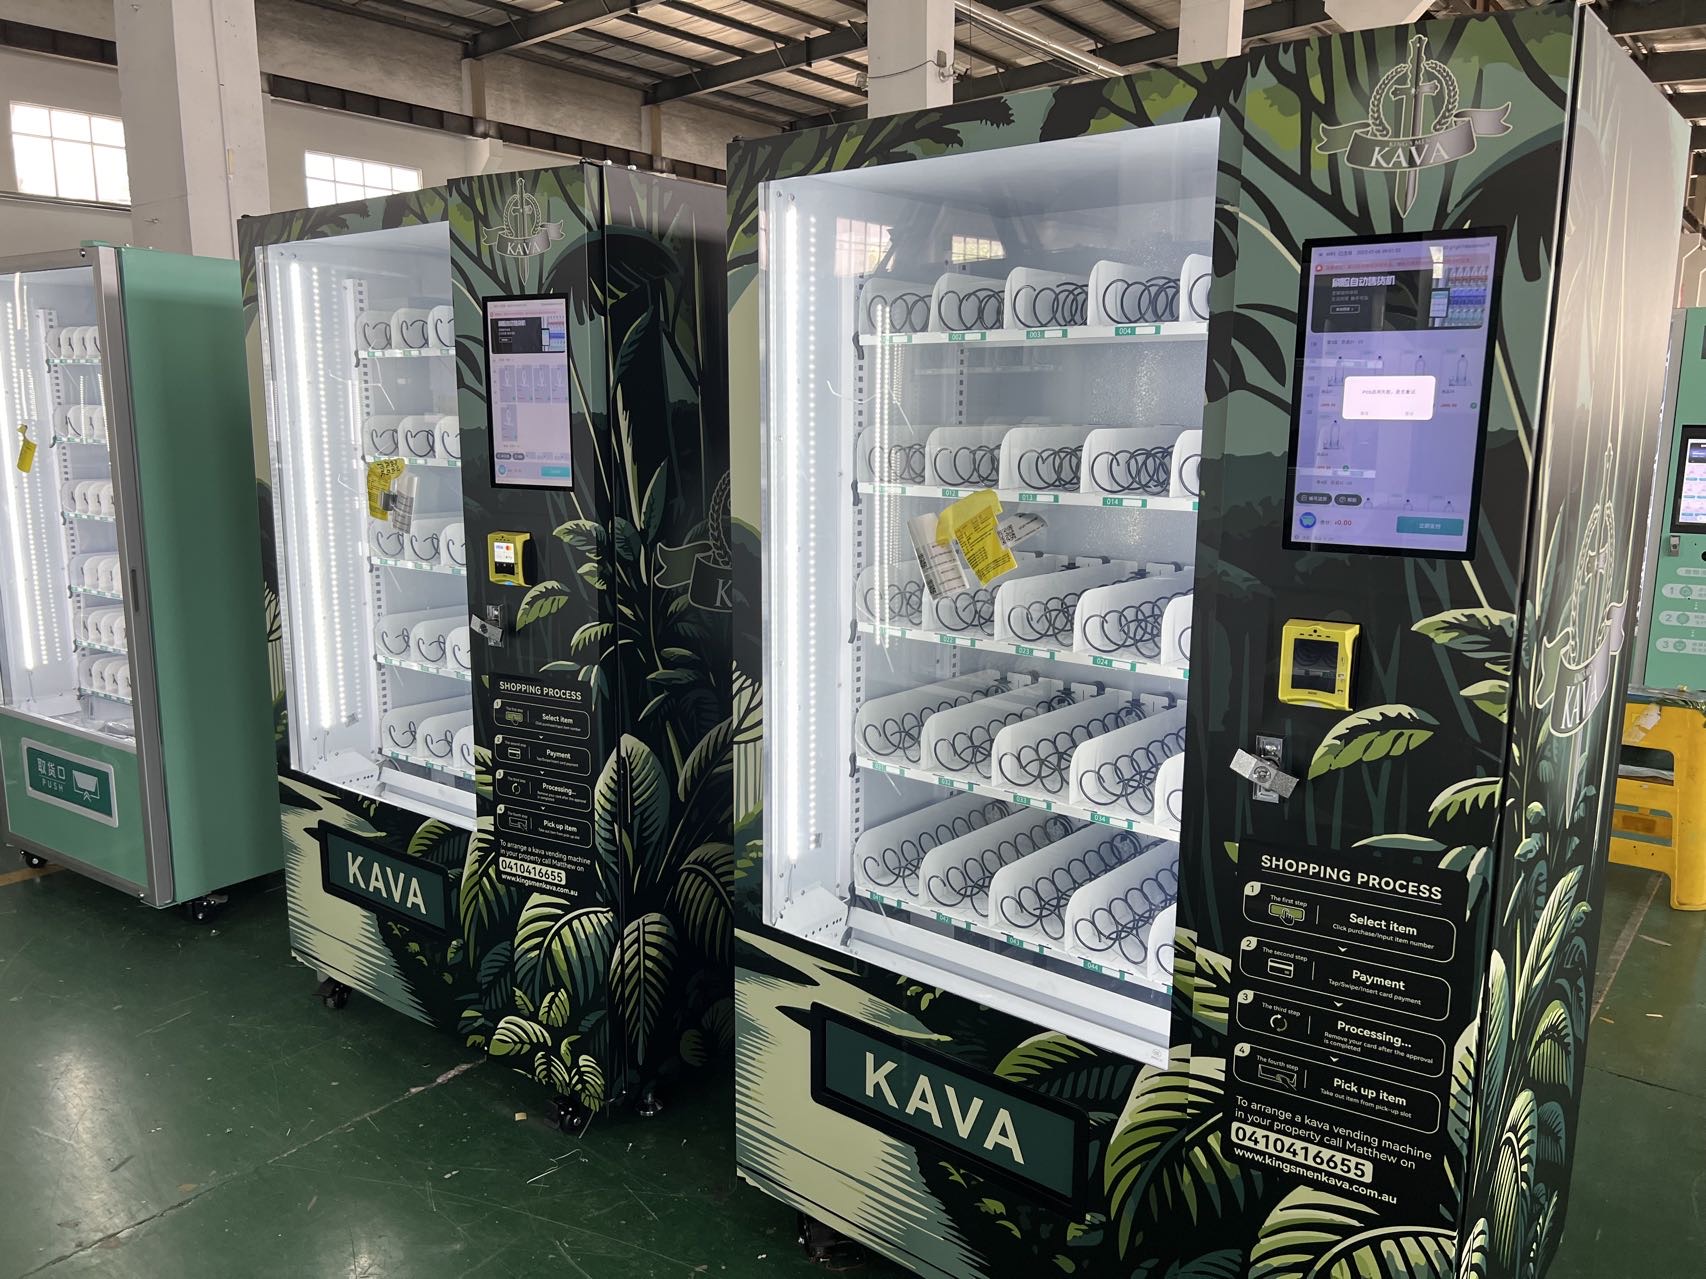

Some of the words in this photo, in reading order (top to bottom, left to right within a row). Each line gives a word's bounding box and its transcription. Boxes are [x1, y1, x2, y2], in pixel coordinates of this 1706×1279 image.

[1370, 142, 1450, 168] KAVA
[508, 241, 540, 255] KAVA
[500, 681, 541, 695] SHOPPING
[544, 688, 582, 700] PROCESS
[1561, 672, 1597, 729] KAVA
[542, 713, 559, 722] Select
[561, 716, 573, 724] item
[546, 749, 570, 759] Payment
[37, 758, 66, 780] 取货口
[42, 778, 64, 792] PUSH
[544, 820, 555, 828] Pick
[565, 823, 577, 832] item
[507, 842, 527, 852] arrange
[532, 846, 544, 854] kava
[546, 850, 567, 860] vending
[568, 855, 590, 865] machine
[519, 853, 541, 864] property
[552, 860, 575, 869] Matthew
[501, 860, 563, 882] 0410416655
[1261, 854, 1351, 882] SHOPPING
[1358, 872, 1442, 900] PROCESS
[347, 851, 427, 915] KAVA
[502, 873, 578, 896] www.kingsmenkava.com.au
[1270, 895, 1282, 903] The
[1282, 896, 1294, 904] first
[1294, 899, 1308, 907] step
[1349, 913, 1387, 930] Select
[1389, 920, 1417, 936] item
[1332, 923, 1347, 932] Click
[1348, 927, 1393, 942] purchase/Input
[1394, 936, 1409, 944] item
[1410, 939, 1435, 950] number
[1262, 946, 1272, 954] The
[1274, 949, 1294, 959] second
[1295, 953, 1308, 962] step
[1328, 978, 1378, 995] Tap/Swipe/Insert
[1379, 990, 1393, 999] card
[1394, 993, 1422, 1006] payment
[1352, 970, 1405, 991] Payment
[1262, 1002, 1272, 1010] The
[1273, 1004, 1287, 1013] third
[1288, 1008, 1301, 1017] step
[1337, 1020, 1412, 1048] Processing...
[1324, 1032, 1347, 1043] Remove
[1348, 1037, 1362, 1046] your
[1363, 1039, 1377, 1048] card
[1378, 1043, 1393, 1054] after
[1394, 1048, 1405, 1057] the
[1405, 1052, 1434, 1064] approval
[1330, 1040, 1361, 1052] completed
[1256, 1055, 1267, 1063] The
[1268, 1057, 1285, 1068] fourth
[1286, 1062, 1298, 1071] step
[1320, 1088, 1333, 1097] Take
[1345, 1095, 1359, 1104] item
[1360, 1099, 1374, 1107] from
[1375, 1103, 1398, 1114] pick-up
[1400, 1109, 1412, 1118] slot
[1334, 1078, 1358, 1094] Pick
[1360, 1085, 1377, 1099] up
[1380, 1089, 1407, 1106] item
[865, 1052, 1025, 1165] KAVA
[1235, 1108, 1245, 1118] in
[1247, 1113, 1271, 1127] your
[1274, 1122, 1321, 1142] property
[1323, 1134, 1343, 1148] call
[1346, 1140, 1398, 1164] Matthew
[1400, 1158, 1416, 1170] on
[1236, 1096, 1248, 1107] To
[1251, 1102, 1292, 1122] arrange
[1304, 1115, 1329, 1131] kava
[1333, 1125, 1378, 1147] vending
[1382, 1138, 1432, 1160] machine
[1235, 1126, 1366, 1178] 0410416655
[1234, 1147, 1397, 1205] www.kingsmenkava.com.au
